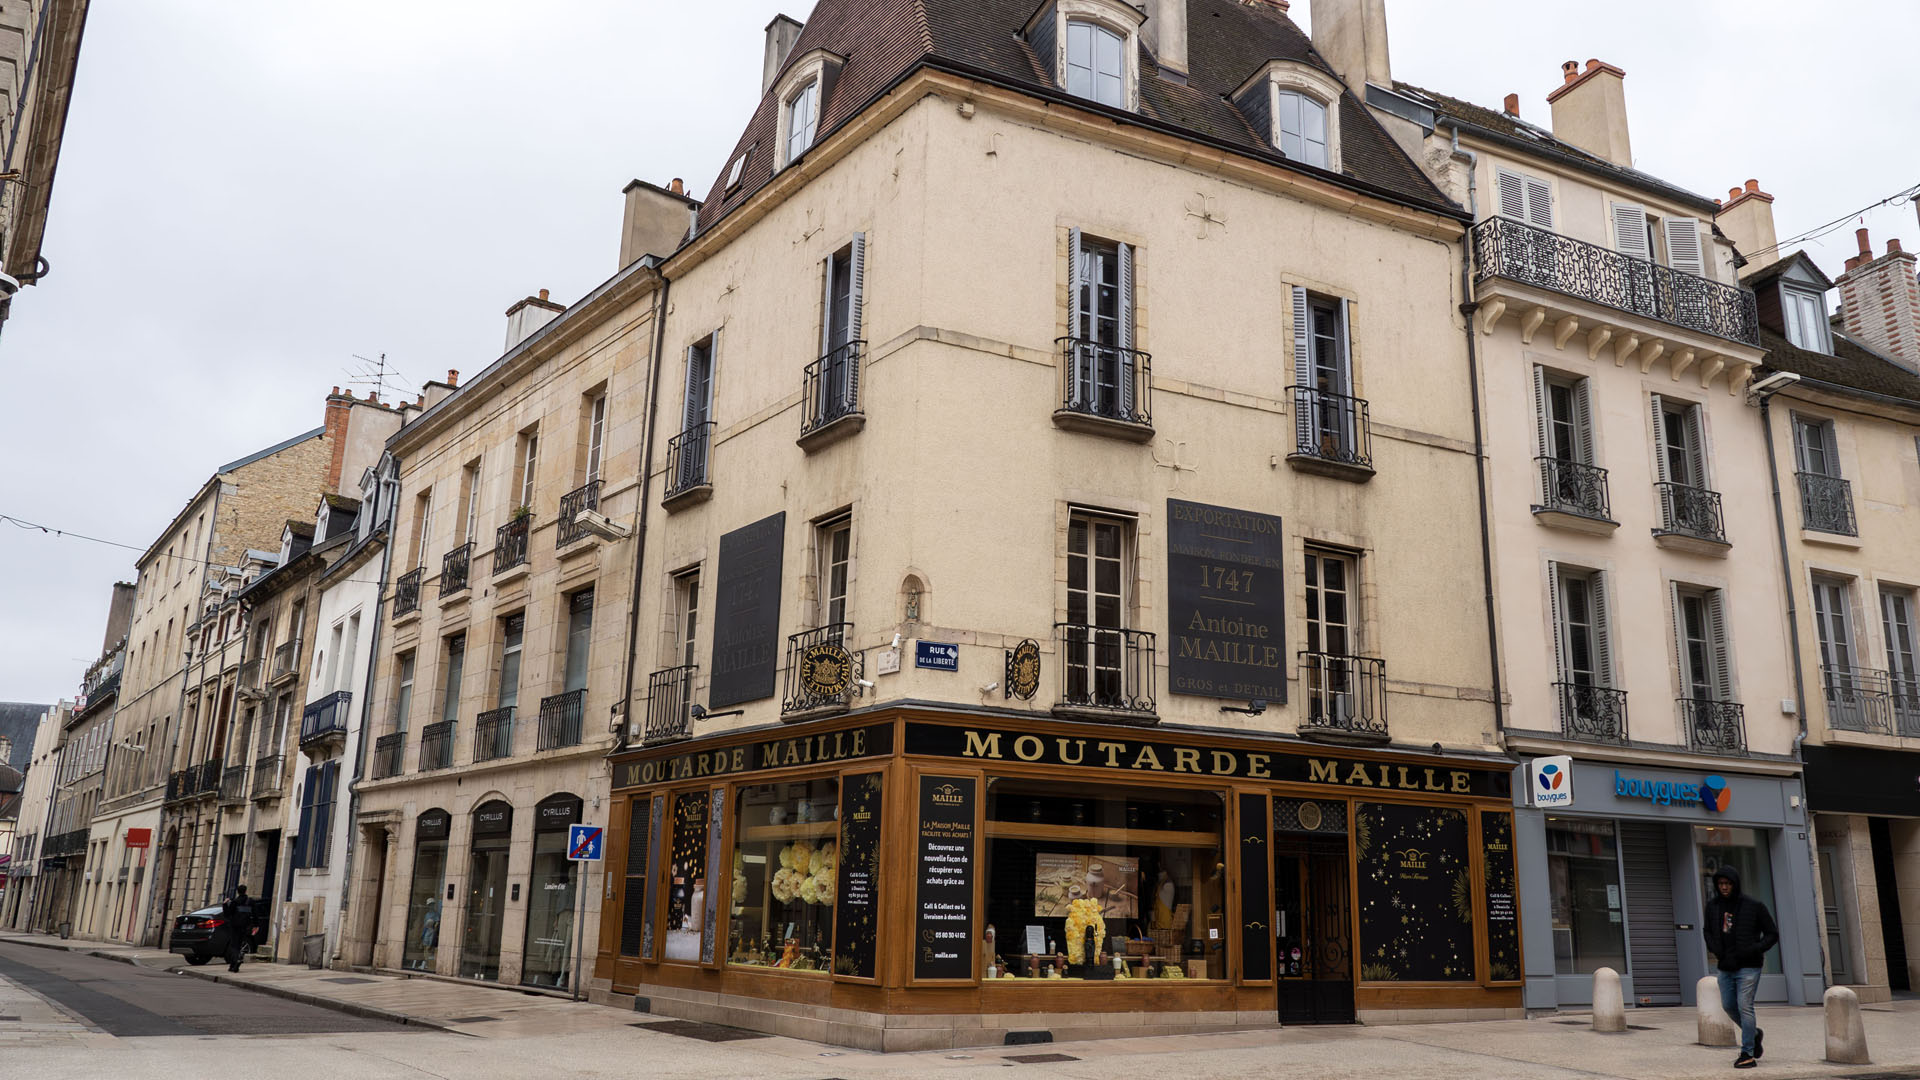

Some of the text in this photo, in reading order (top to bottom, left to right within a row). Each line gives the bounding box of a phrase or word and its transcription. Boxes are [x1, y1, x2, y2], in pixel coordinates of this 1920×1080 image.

[1175, 504, 1278, 536] EXPORTATION
[1200, 565, 1255, 593] 1747
[1188, 609, 1269, 639] Antoine
[811, 647, 842, 661] MAILLE
[929, 646, 945, 655] RUE
[1179, 636, 1279, 668] MAILLE
[1176, 676, 1213, 690] GROS
[1234, 683, 1281, 698] DETAIL
[626, 729, 867, 785] MOUTARDE MAILLE
[962, 731, 1471, 793] MOUTARDE MAILLE
[1615, 768, 1700, 806] bouygues
[932, 794, 964, 803] MAILLE
[1537, 792, 1567, 803] bouygues
[479, 812, 503, 822] CYRILLUS
[542, 807, 571, 817] CYRILLUS
[928, 842, 954, 851] Découvrez
[924, 854, 968, 864] nouvelle façon de
[928, 866, 953, 875] récupérer
[943, 877, 957, 886] grâce
